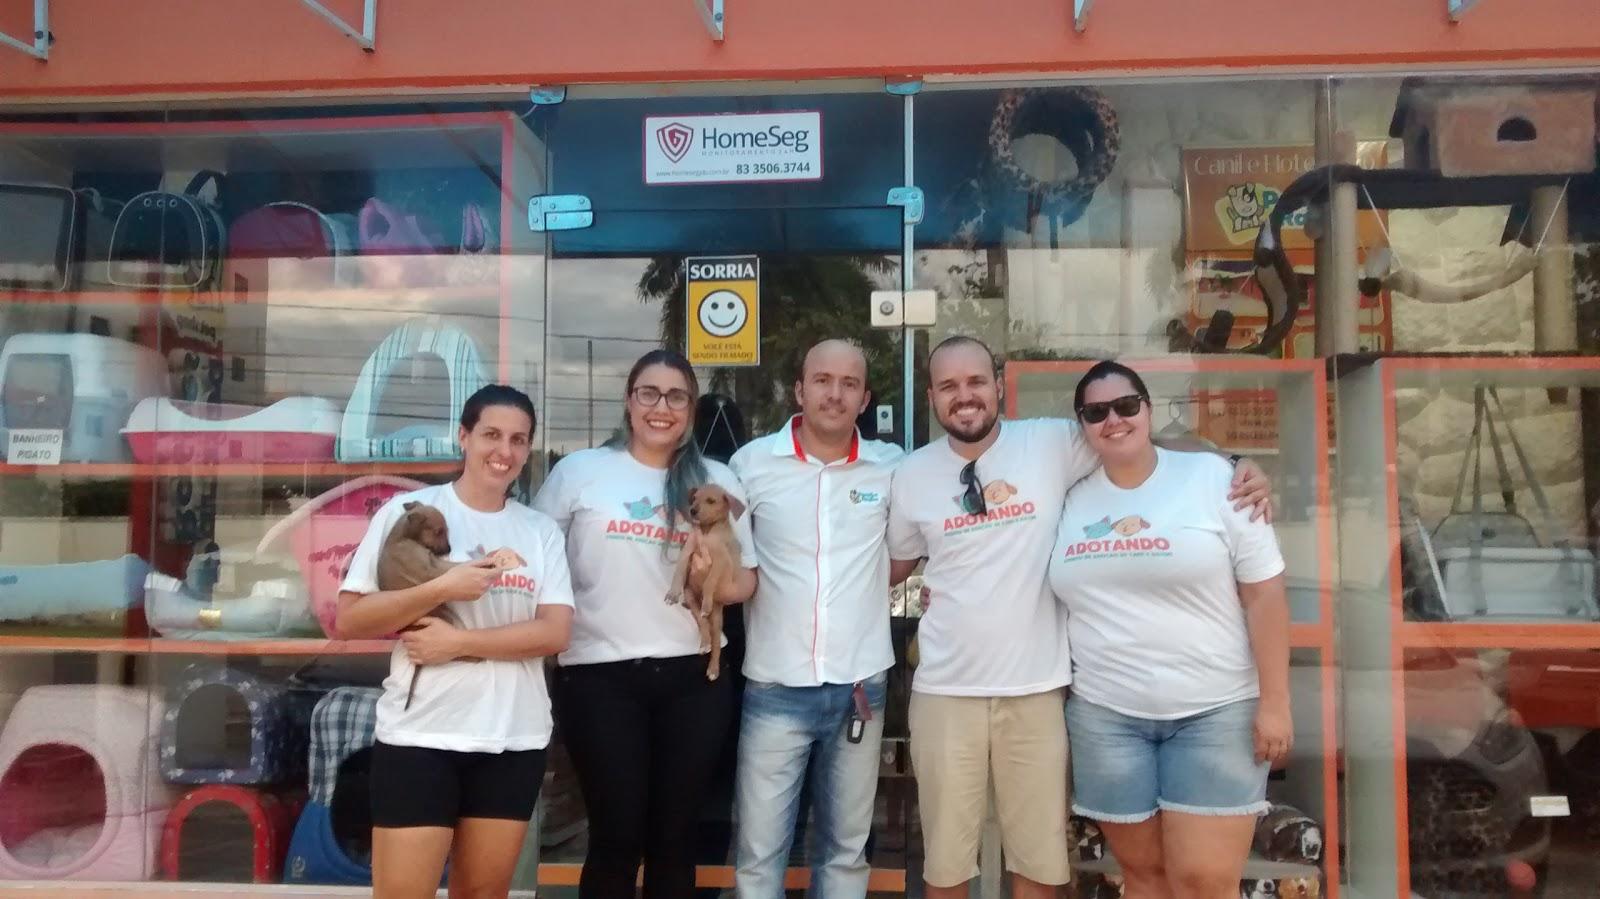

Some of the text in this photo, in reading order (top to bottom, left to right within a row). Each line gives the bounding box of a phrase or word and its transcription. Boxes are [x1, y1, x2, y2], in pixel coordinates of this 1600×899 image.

[702, 125, 809, 153] HomeSeg
[736, 161, 810, 175] 83 3506.3744
[1194, 152, 1243, 175] Canil
[1264, 154, 1316, 174] Hote
[690, 263, 755, 279] SORRIA
[943, 501, 1035, 532] ADOTANDO
[1064, 537, 1170, 557] ADOTANDO
